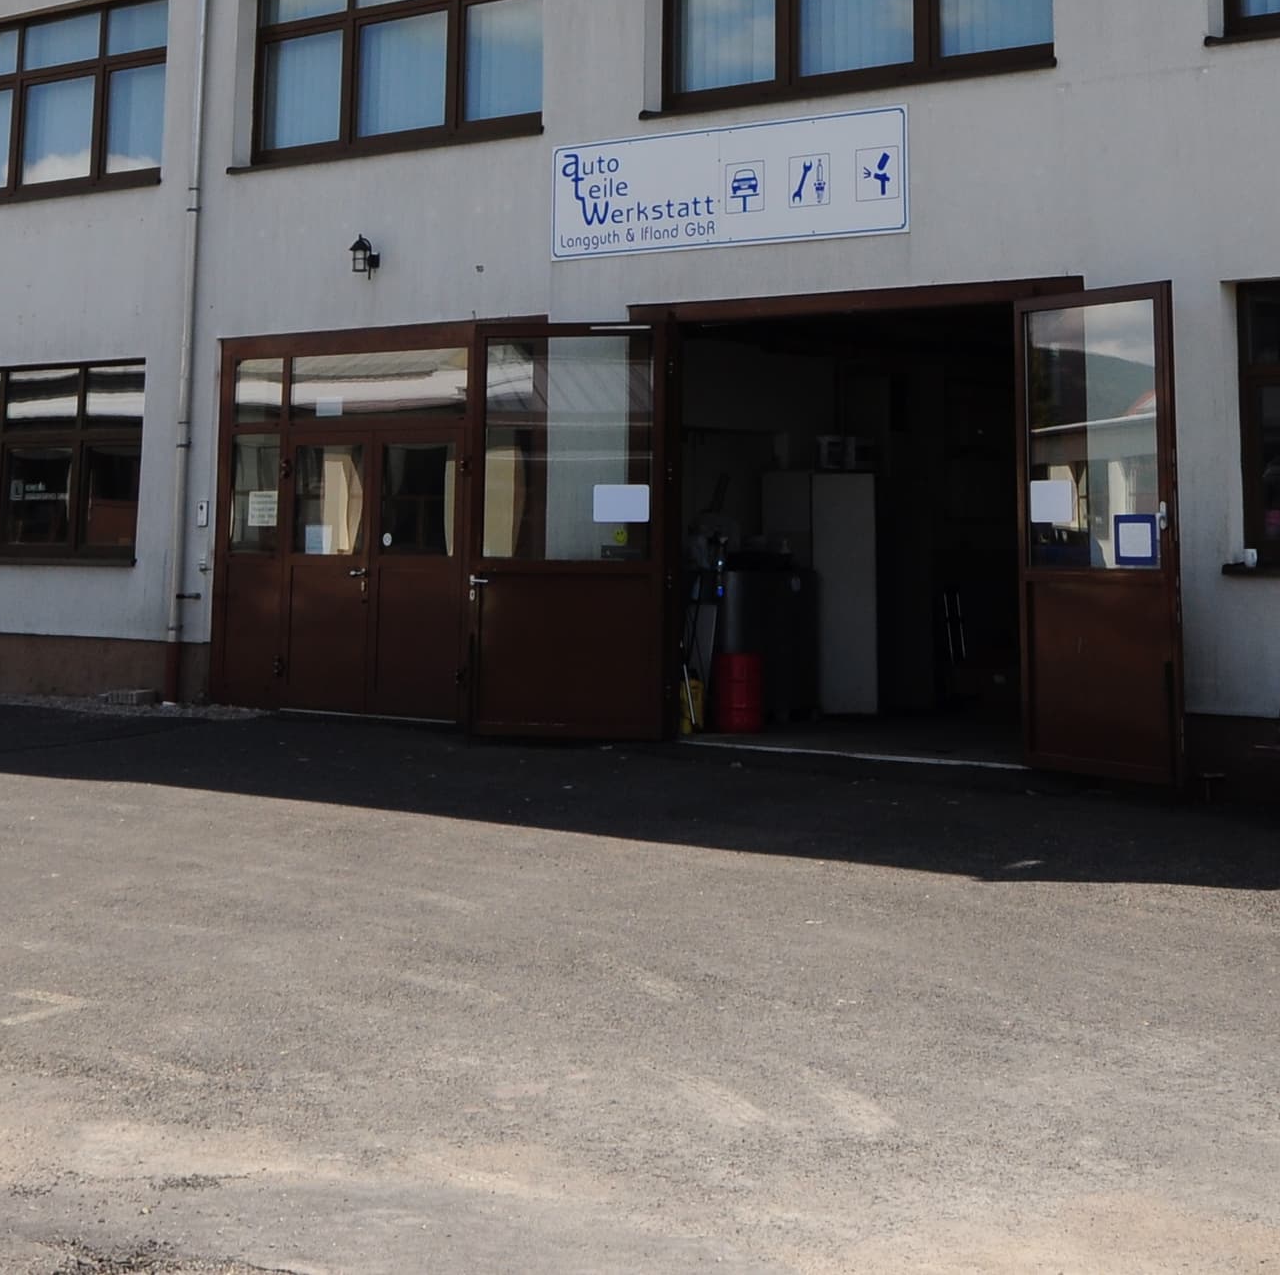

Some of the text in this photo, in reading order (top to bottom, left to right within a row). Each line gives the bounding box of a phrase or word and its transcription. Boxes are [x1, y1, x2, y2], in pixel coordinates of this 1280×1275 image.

[562, 153, 619, 178] auto
[581, 196, 714, 226] Werkstatt
[626, 228, 635, 242] &
[685, 220, 715, 237] GbR
